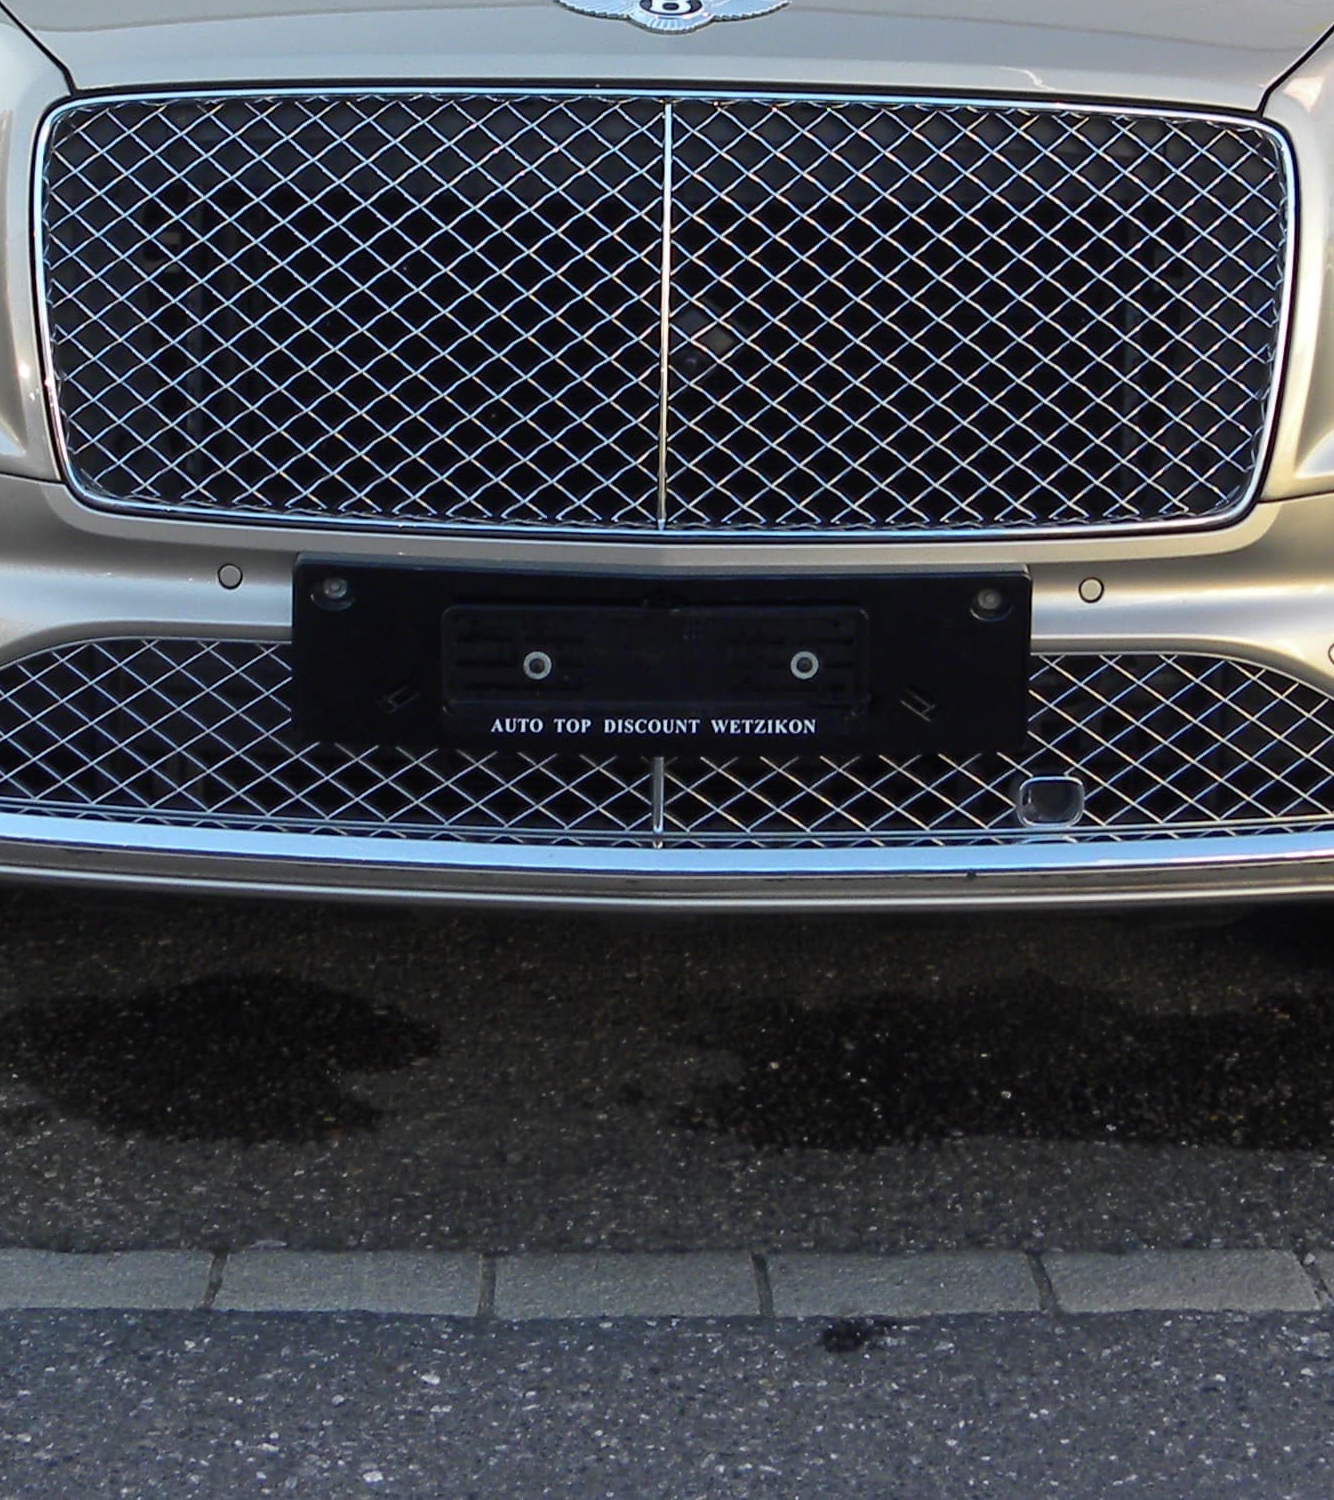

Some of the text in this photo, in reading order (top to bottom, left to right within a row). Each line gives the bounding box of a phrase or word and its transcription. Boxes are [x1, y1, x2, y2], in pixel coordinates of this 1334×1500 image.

[490, 718, 817, 734] AUTO TOP DISCOUNT WETZIKON
